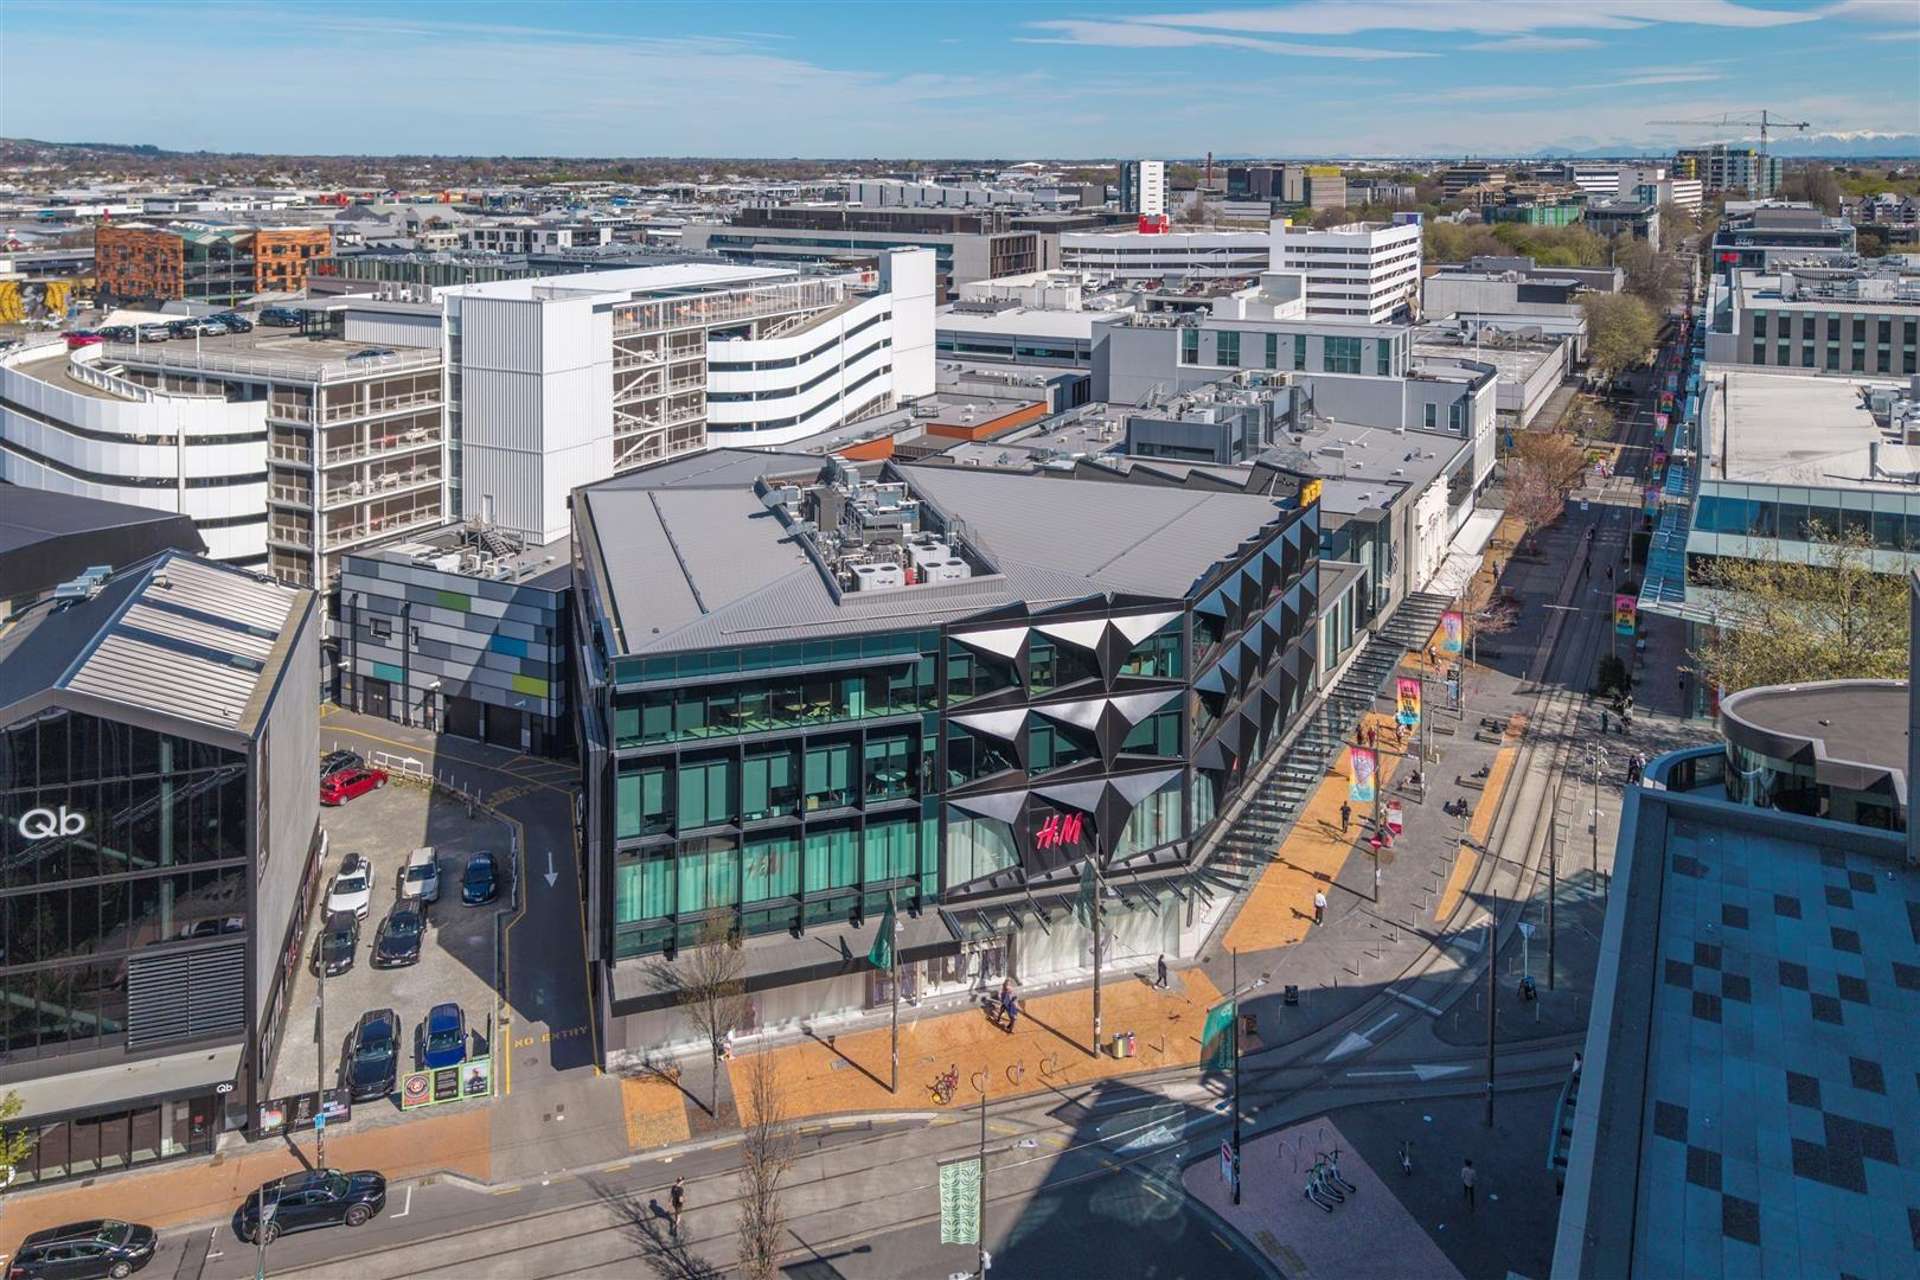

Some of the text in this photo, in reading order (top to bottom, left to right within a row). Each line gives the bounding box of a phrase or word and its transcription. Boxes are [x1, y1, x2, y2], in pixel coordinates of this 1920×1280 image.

[19, 805, 86, 839] Qb
[1036, 812, 1082, 849] H&M
[513, 1026, 587, 1048] NO ENTRY
[216, 1083, 233, 1093] Qb
